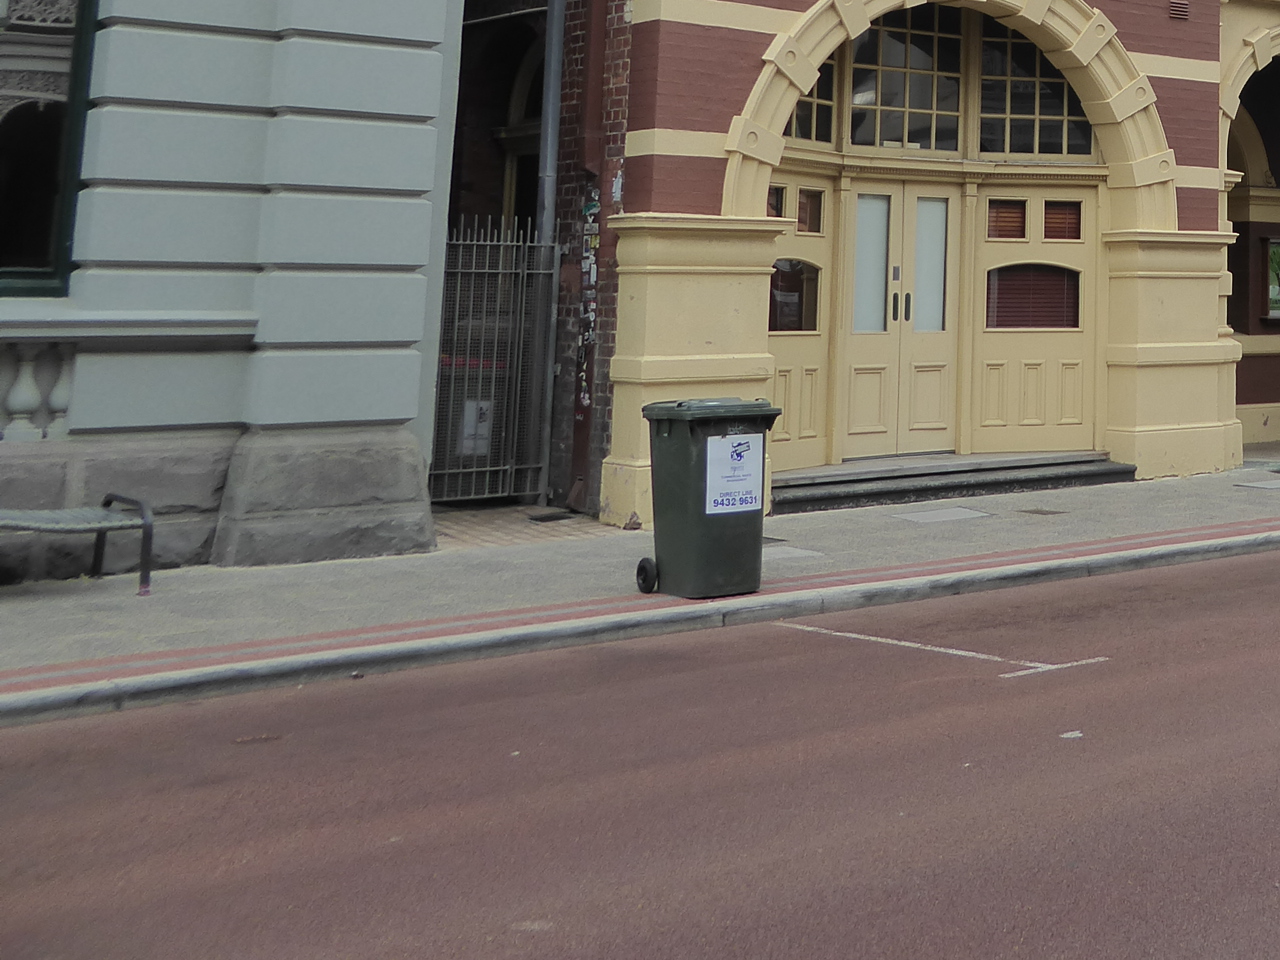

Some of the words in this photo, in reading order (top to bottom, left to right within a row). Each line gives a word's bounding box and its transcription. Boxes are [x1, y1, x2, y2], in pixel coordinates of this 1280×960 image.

[720, 490, 740, 498] DIRECT
[713, 497, 736, 508] 9432
[738, 495, 757, 505] 9631
